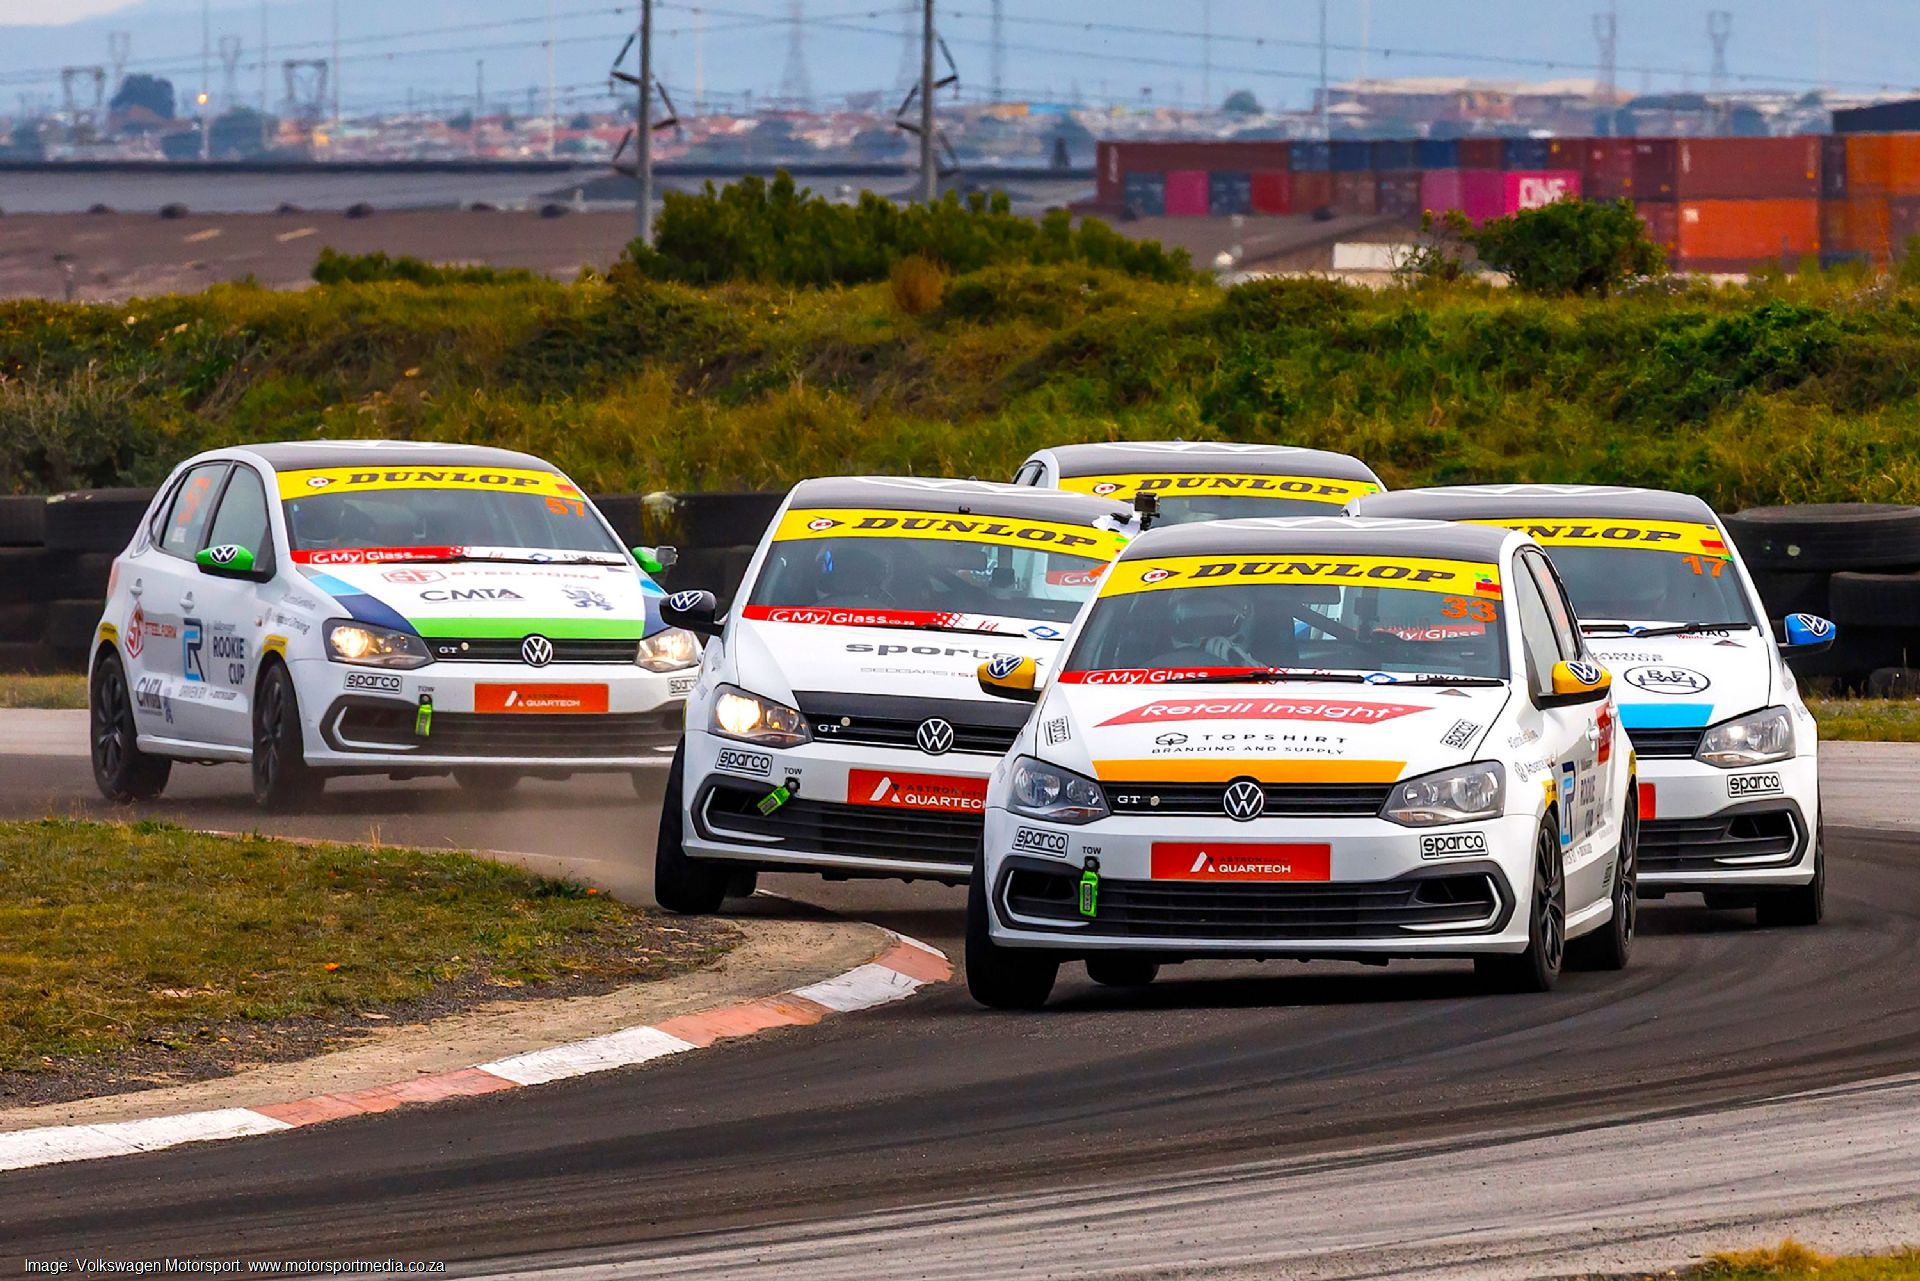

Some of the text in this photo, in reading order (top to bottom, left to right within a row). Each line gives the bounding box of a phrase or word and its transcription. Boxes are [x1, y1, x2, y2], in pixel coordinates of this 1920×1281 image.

[346, 471, 541, 487] DUNLOP
[1134, 477, 1350, 495] DUNLOP
[852, 517, 1097, 546] DUNLOP
[1504, 525, 1681, 542] NLOP
[1188, 562, 1456, 583] DUNLOP
[1683, 555, 1728, 577] 17
[419, 588, 524, 601] CMTA
[1440, 596, 1497, 623] 33
[213, 636, 245, 659] ROOKIE
[439, 646, 458, 654] GT
[228, 663, 245, 685] CUP
[347, 674, 400, 689] sparco
[1140, 702, 1391, 719] Retail Insight
[817, 724, 841, 733] GT
[1202, 733, 1348, 744] TOPSHIRT
[1151, 745, 1235, 755] BRANDING
[1284, 746, 1345, 755] SUPPLY
[720, 751, 769, 769] sparco
[784, 767, 802, 775] TOW
[1729, 775, 1780, 794] sparco
[904, 794, 986, 809] QUARTEC
[1117, 795, 1140, 804] GT
[1016, 830, 1066, 850] sparco
[1423, 835, 1484, 856] sparco
[1082, 846, 1101, 855] TOW
[1218, 864, 1291, 873] QUARTECH
